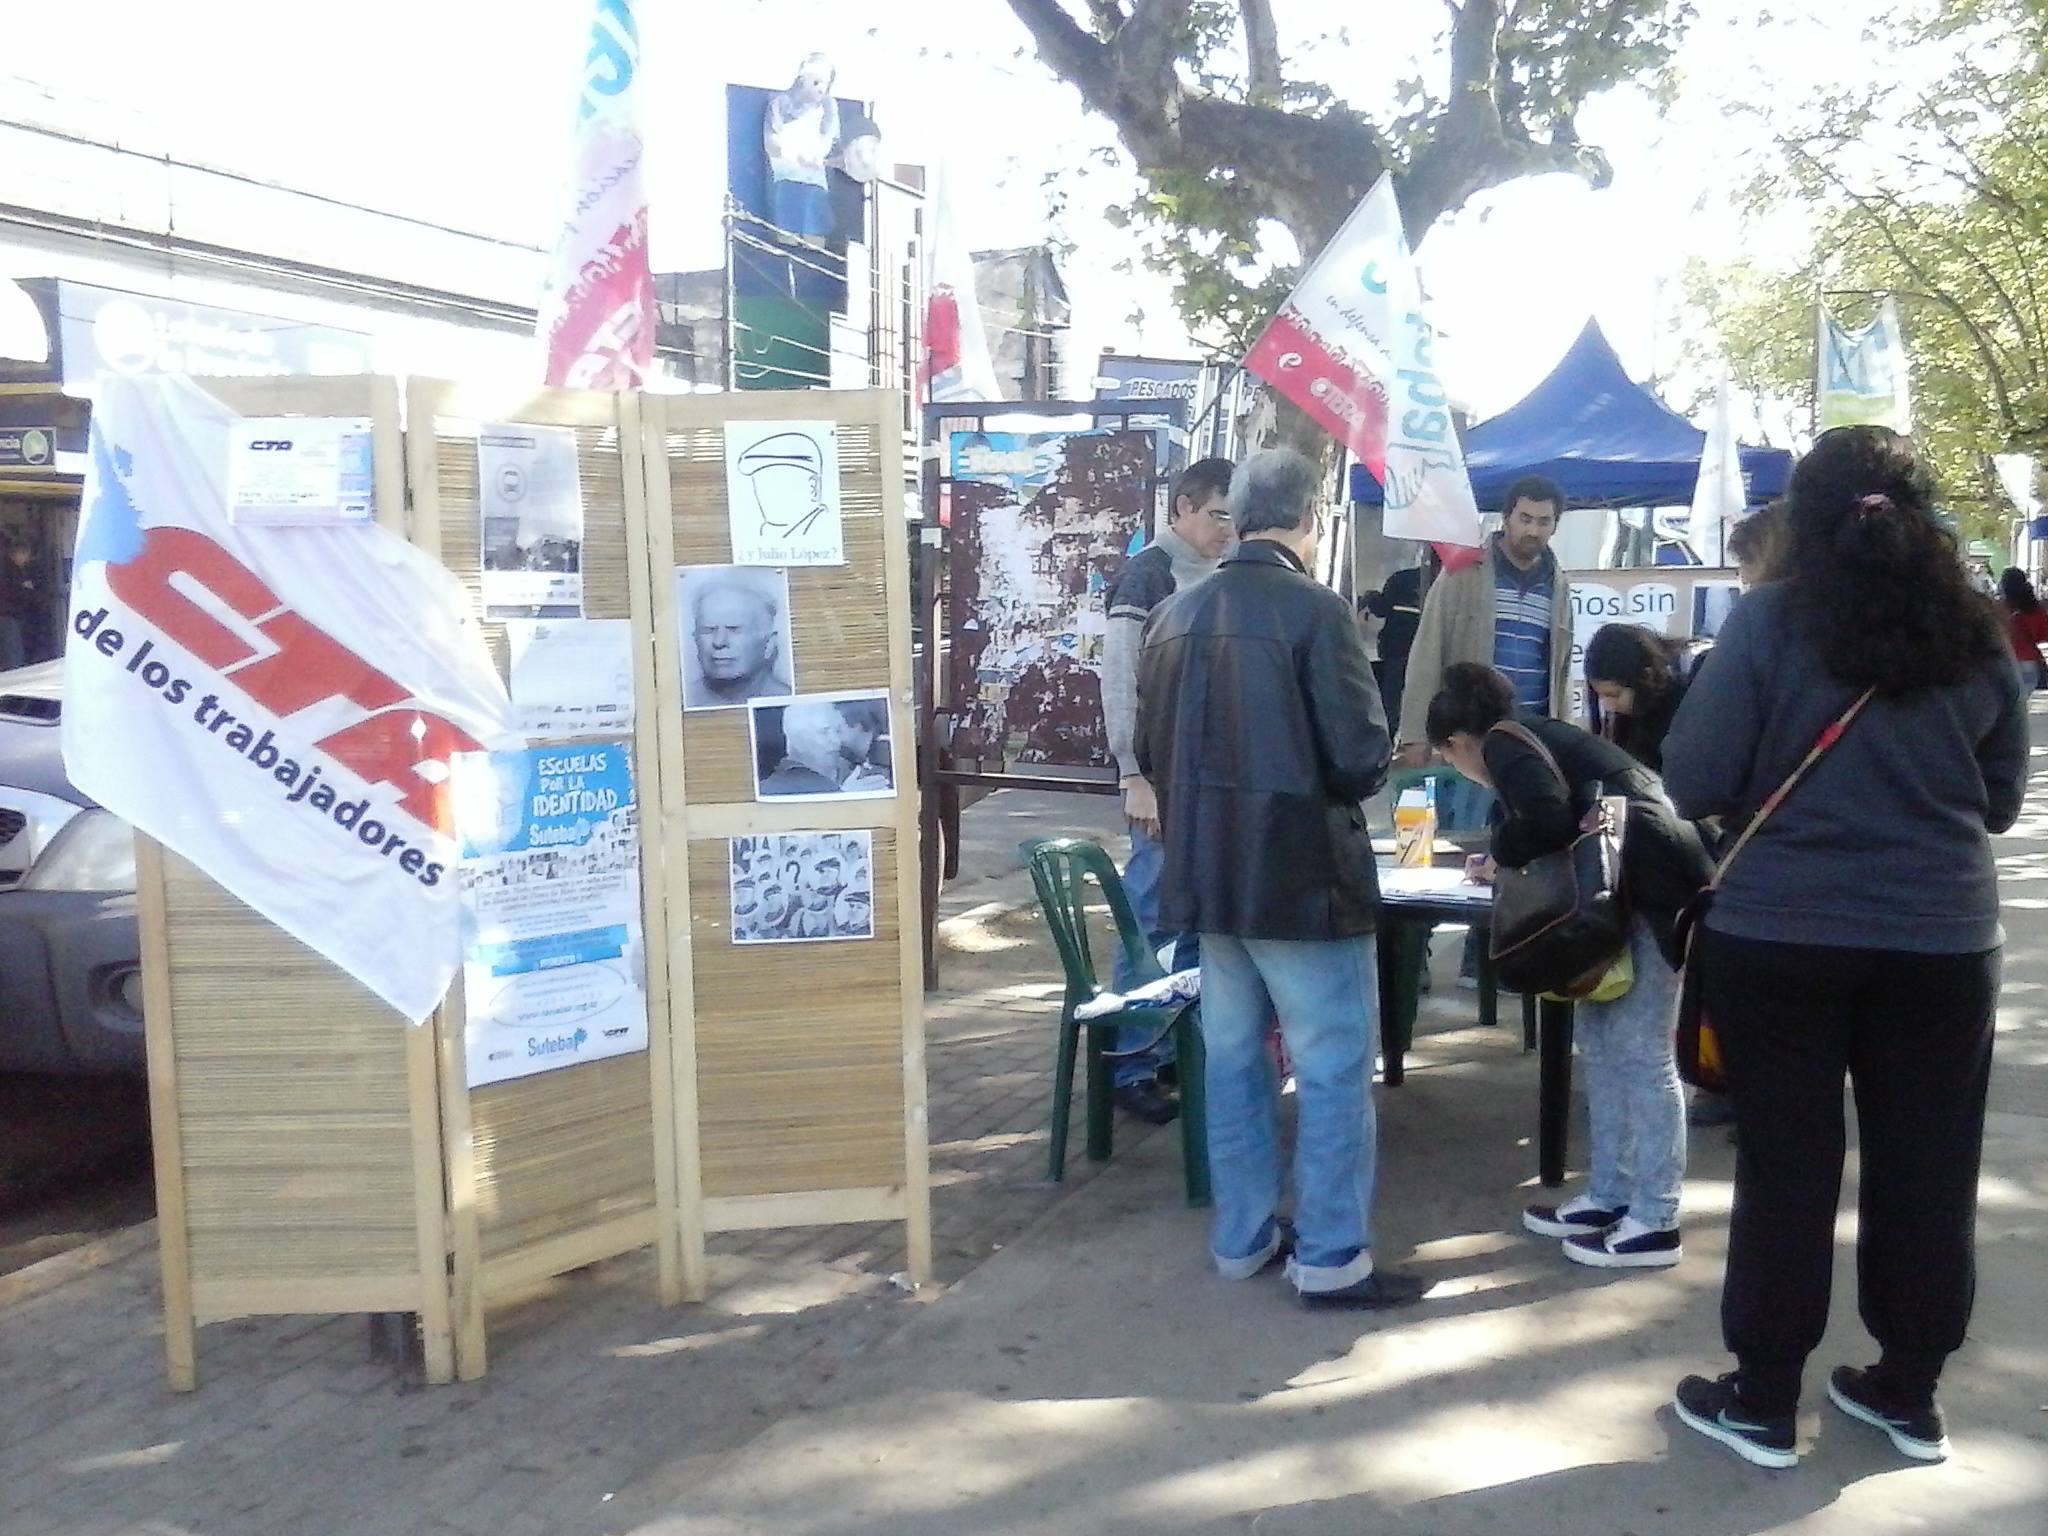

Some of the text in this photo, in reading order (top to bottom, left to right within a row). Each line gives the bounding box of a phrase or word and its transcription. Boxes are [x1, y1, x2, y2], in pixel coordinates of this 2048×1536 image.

[1131, 379, 1198, 400] PESCADOS
[757, 547, 787, 561] Julio
[790, 546, 838, 563] López?
[1631, 586, 1675, 613] sin
[106, 526, 490, 842] CTA
[74, 607, 445, 888] de los trabajadores
[537, 752, 608, 776] ESCUELAS
[568, 775, 586, 790] LA
[532, 788, 619, 818] IDENTIDAD
